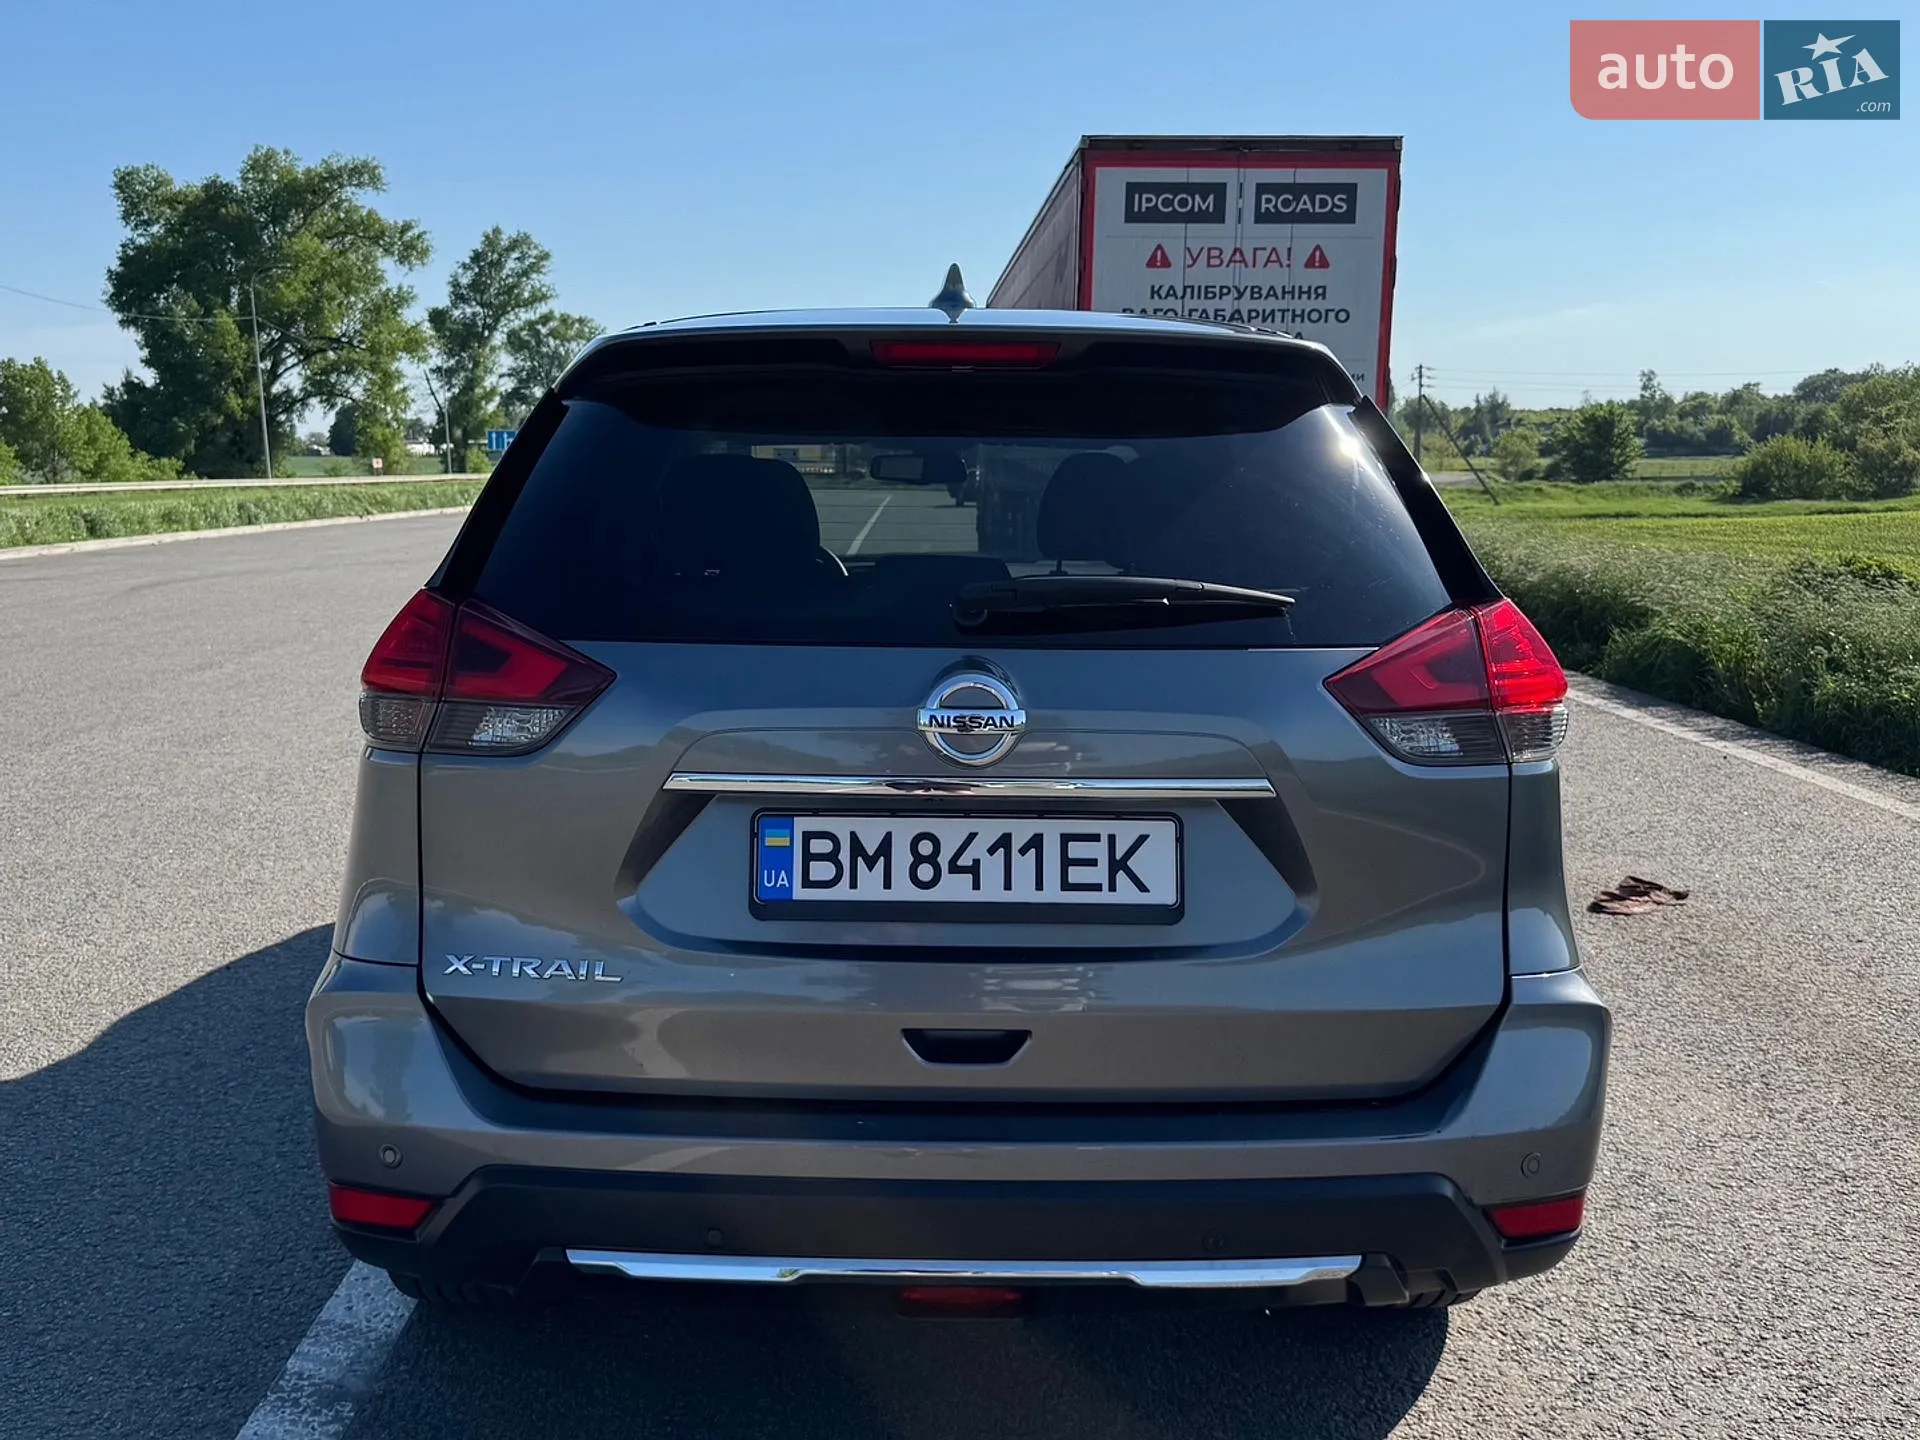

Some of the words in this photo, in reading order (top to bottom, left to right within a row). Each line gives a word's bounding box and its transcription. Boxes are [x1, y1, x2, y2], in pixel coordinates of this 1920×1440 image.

[1133, 193, 1215, 213] IPCOM
[1260, 194, 1348, 213] ROADS
[1186, 246, 1293, 269] УВАГА!
[1149, 284, 1328, 301] КАЛІБРУВАННЯ
[929, 714, 1015, 729] NISSAN
[763, 869, 790, 889] UA
[443, 954, 624, 983] X-TRAIL
